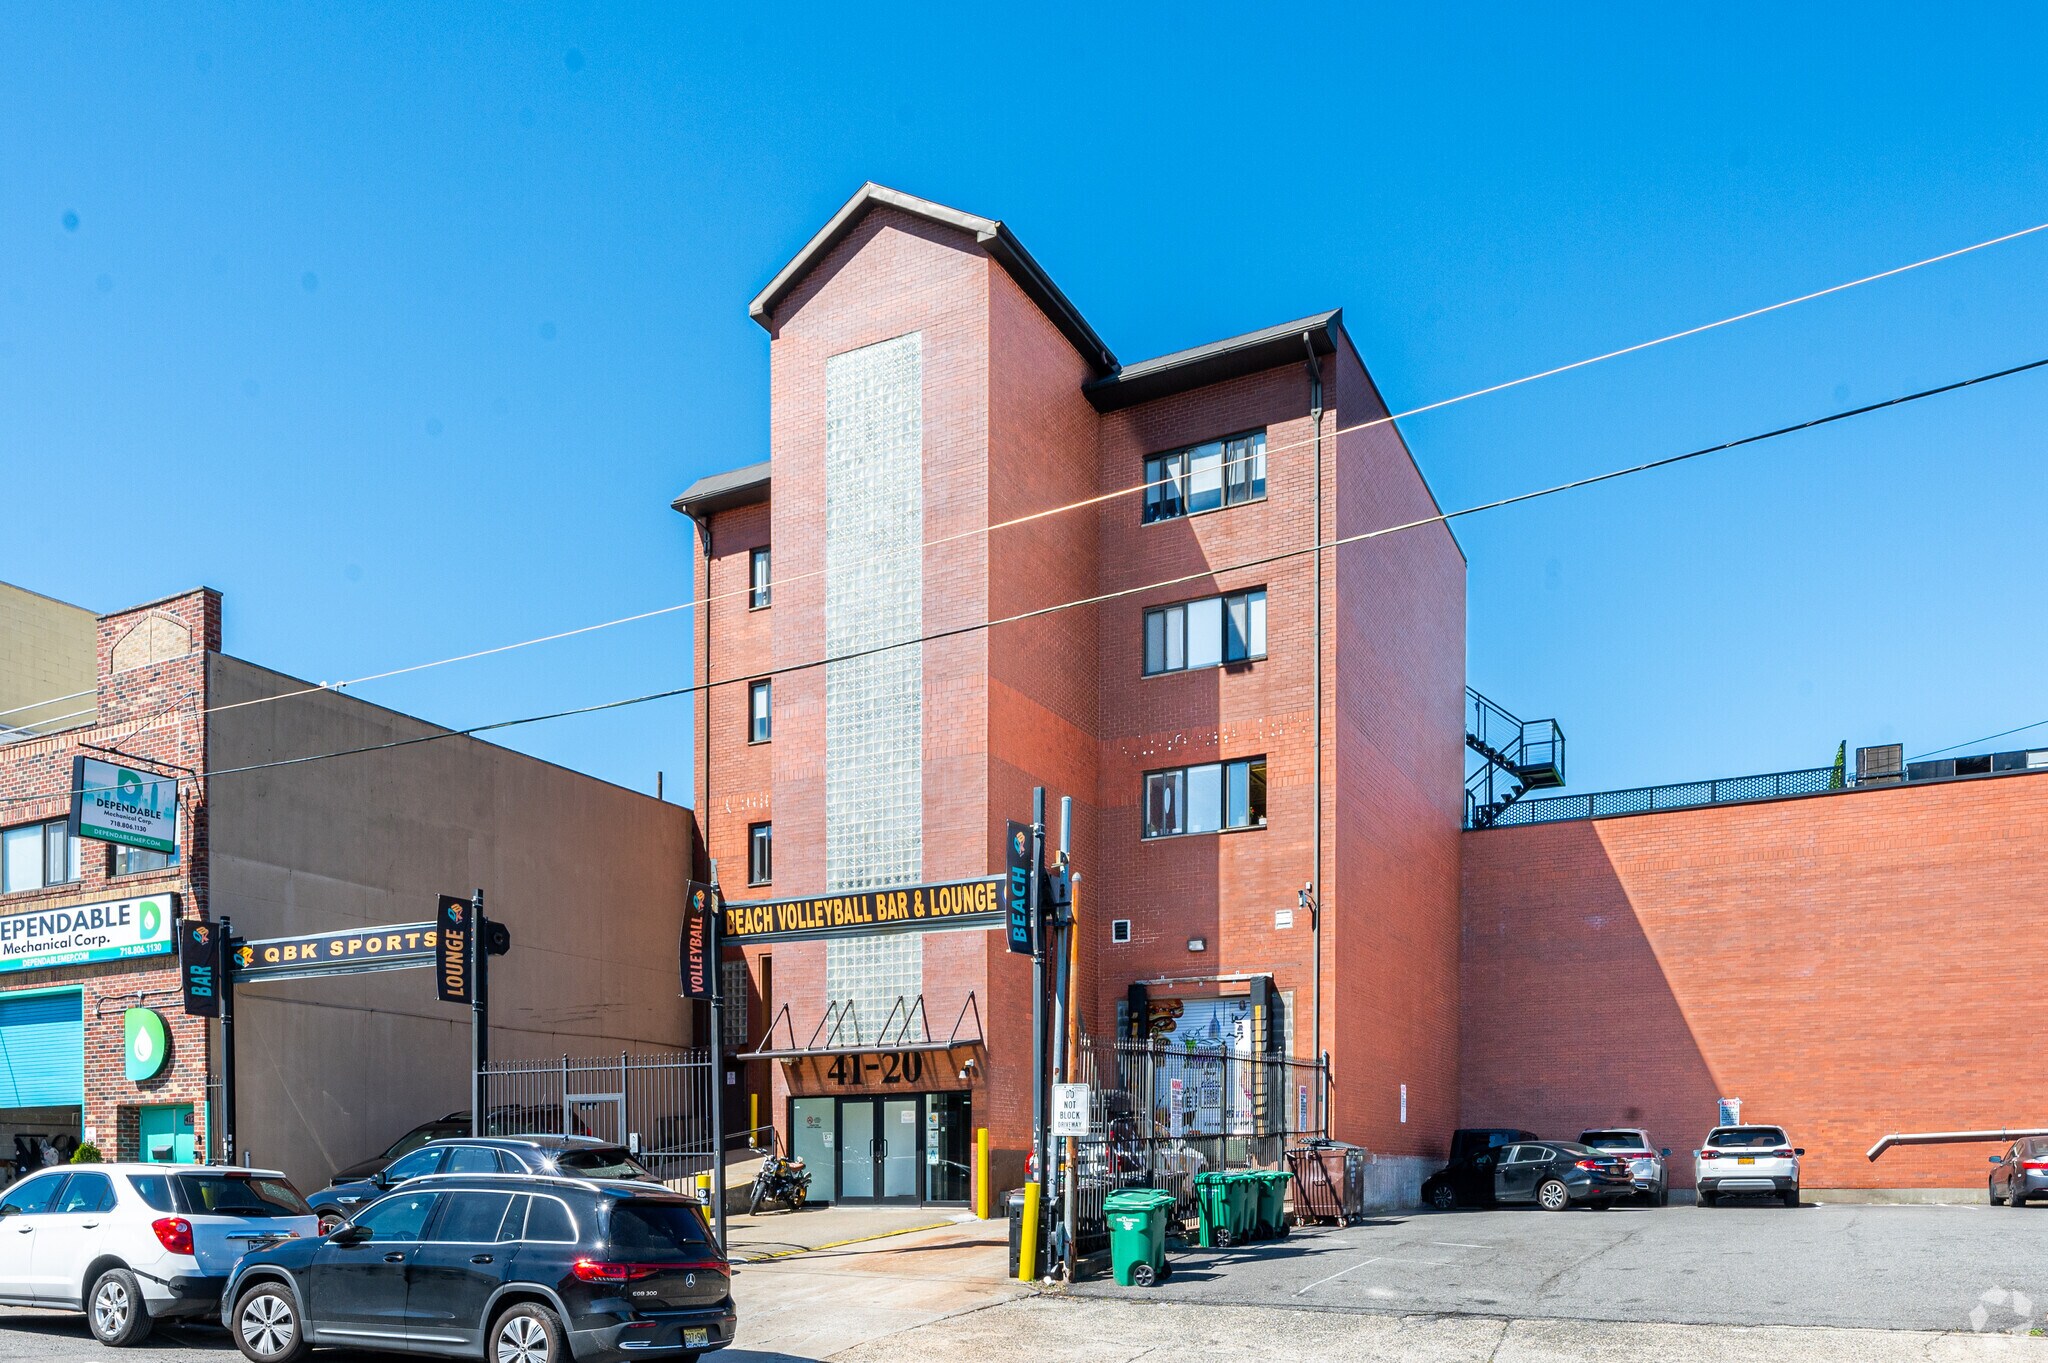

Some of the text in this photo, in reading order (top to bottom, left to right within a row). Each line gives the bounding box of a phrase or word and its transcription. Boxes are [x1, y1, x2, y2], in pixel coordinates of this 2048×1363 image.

[97, 798, 161, 820] DEPENDABLE
[104, 810, 153, 825] Mechanical Corp.
[94, 828, 161, 846] DEPENDABLEMEP.COM
[110, 819, 147, 833] 718.806.1130
[726, 882, 998, 935] BEACH VOLLEYBALL BAR & LOUNGE
[1011, 866, 1027, 942] BEACH
[0, 904, 131, 941] EPENDABLE
[3, 933, 111, 955] Mechanical Corp.
[119, 943, 162, 956] 718.806.1130
[264, 931, 438, 963] QBK SPORTS
[689, 916, 704, 993] VOLLEYBALL
[22, 952, 90, 967] DEPENDABLEMEP.COM
[445, 929, 465, 997] LOUNGE
[190, 965, 212, 996] BAR
[827, 1051, 923, 1086] 41-20
[1064, 1101, 1077, 1109] NOT
[1066, 1090, 1075, 1099] DO
[1059, 1111, 1081, 1120] BLOCK
